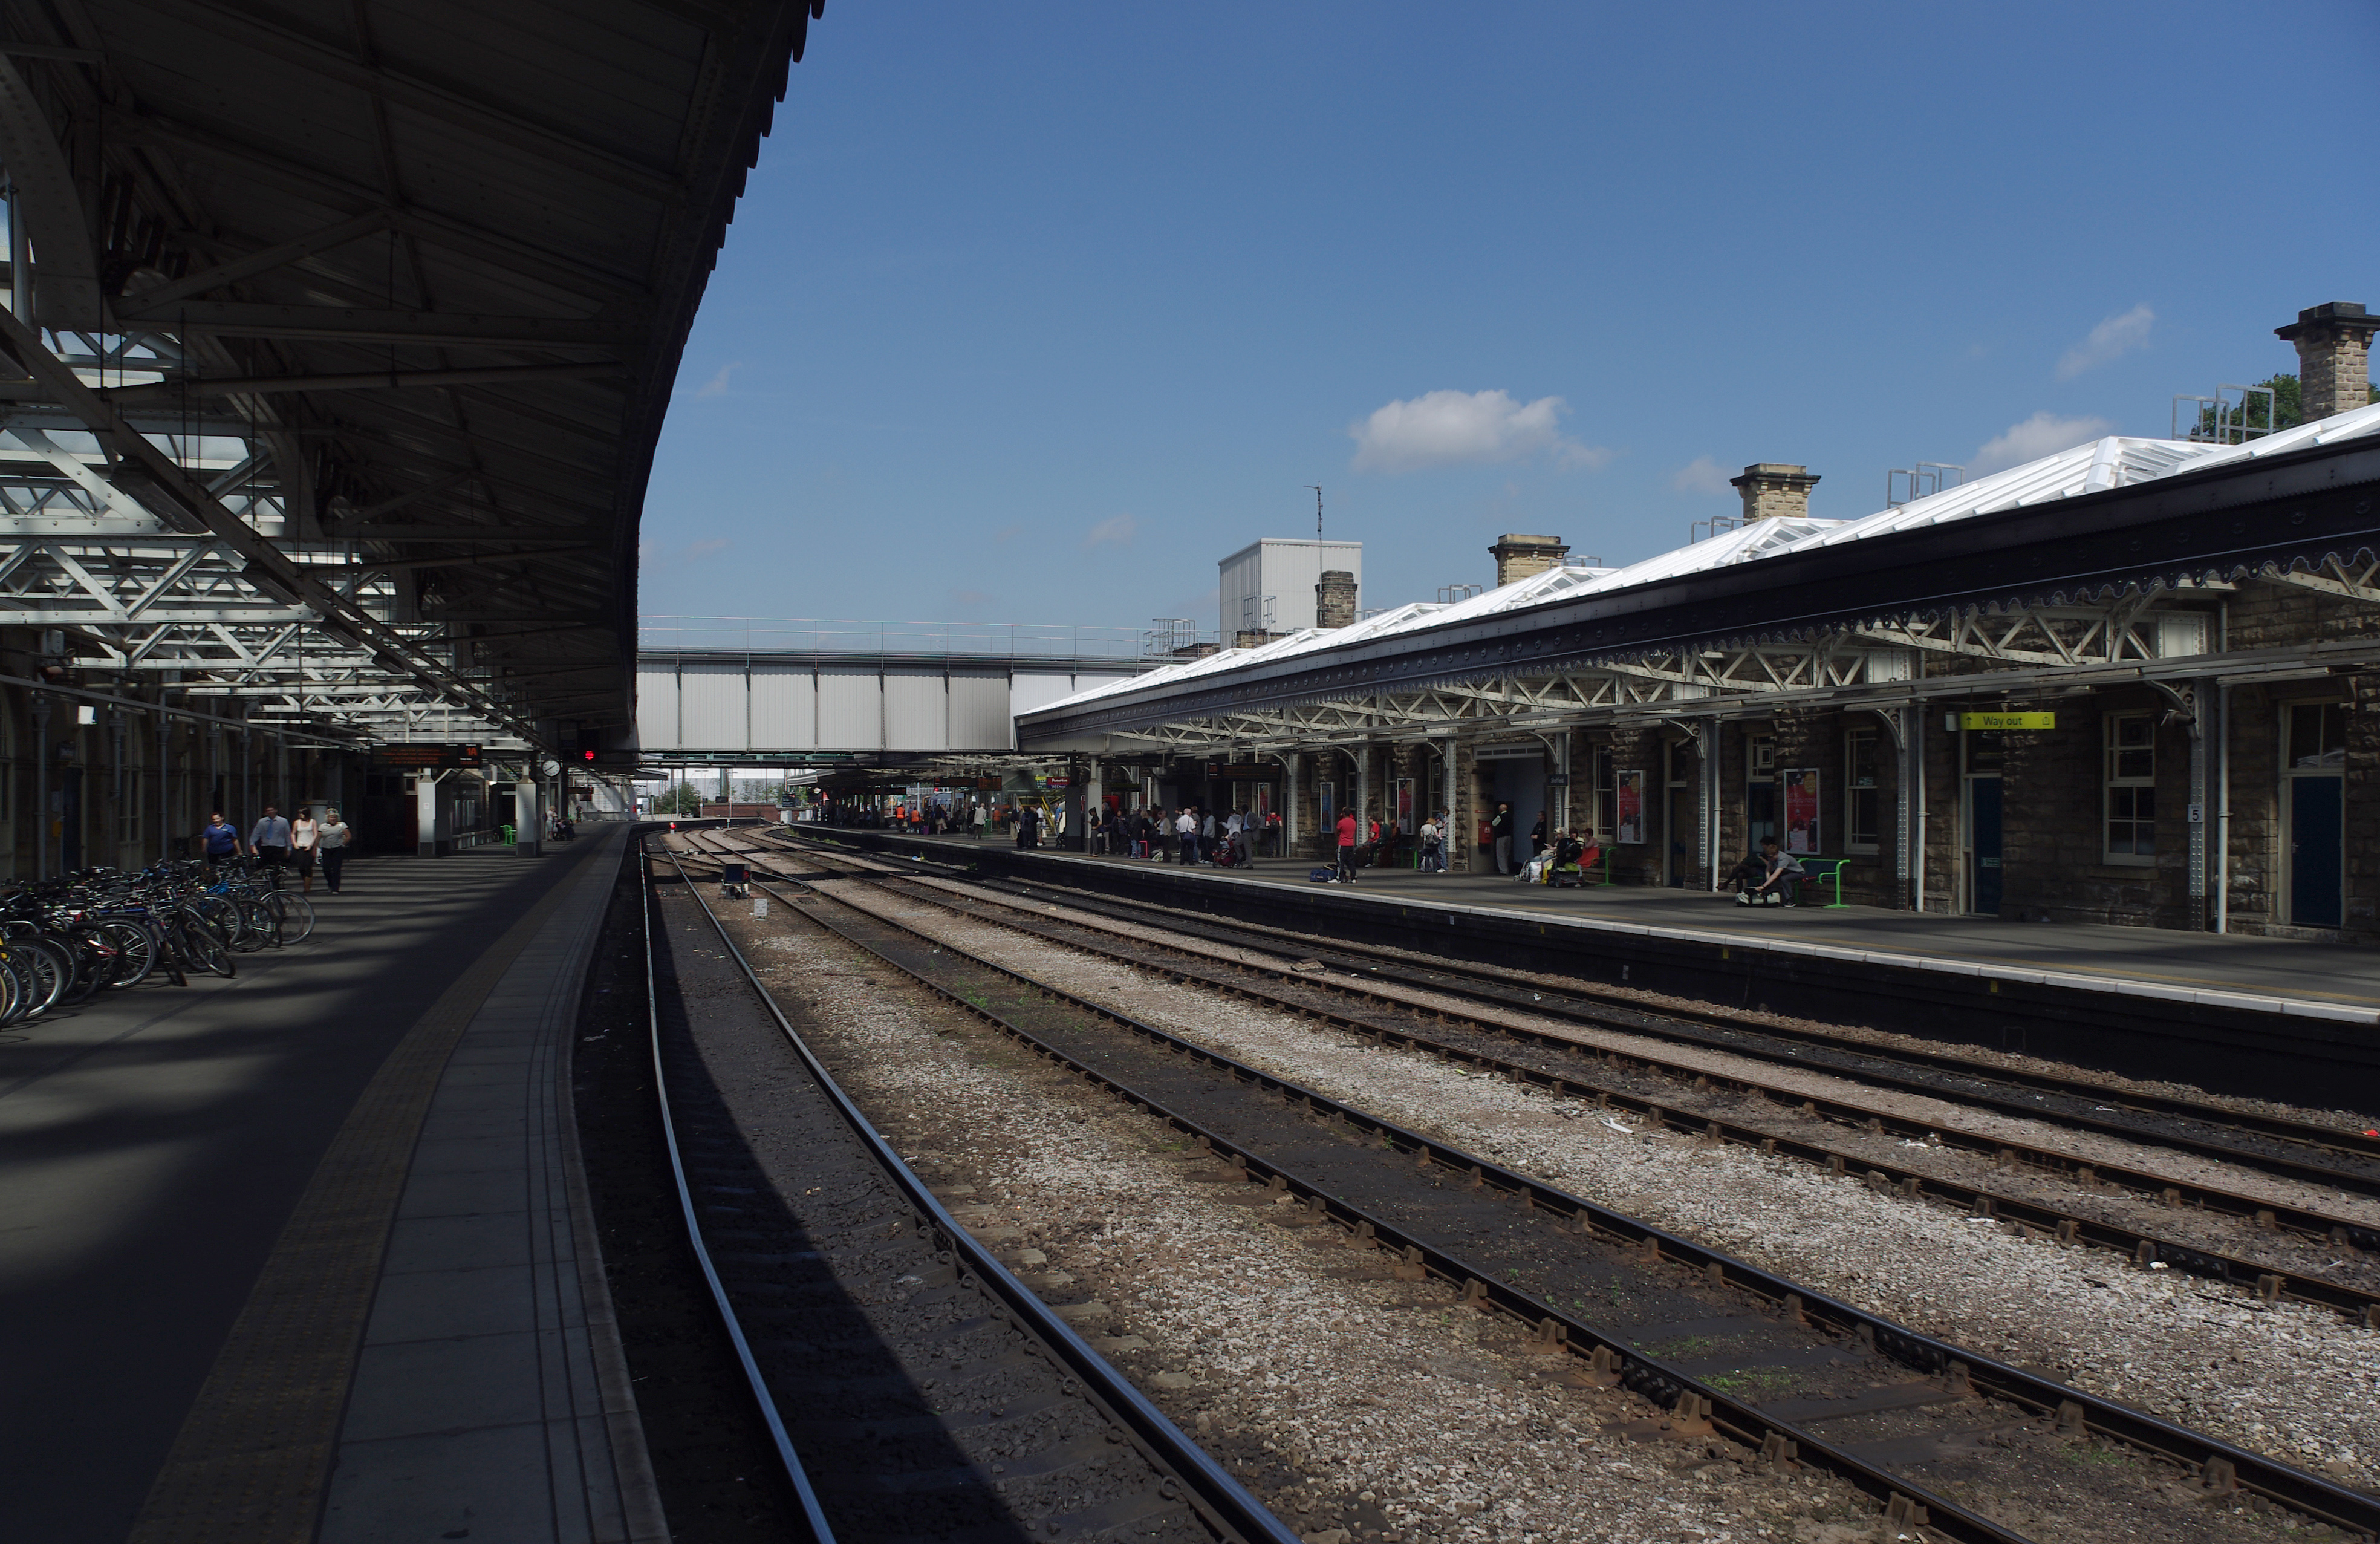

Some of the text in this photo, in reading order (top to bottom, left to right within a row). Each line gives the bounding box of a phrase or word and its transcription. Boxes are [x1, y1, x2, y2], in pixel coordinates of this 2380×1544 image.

[1983, 716, 2022, 728] Way out
[467, 747, 478, 756] 1A
[2193, 810, 2199, 821] 5
